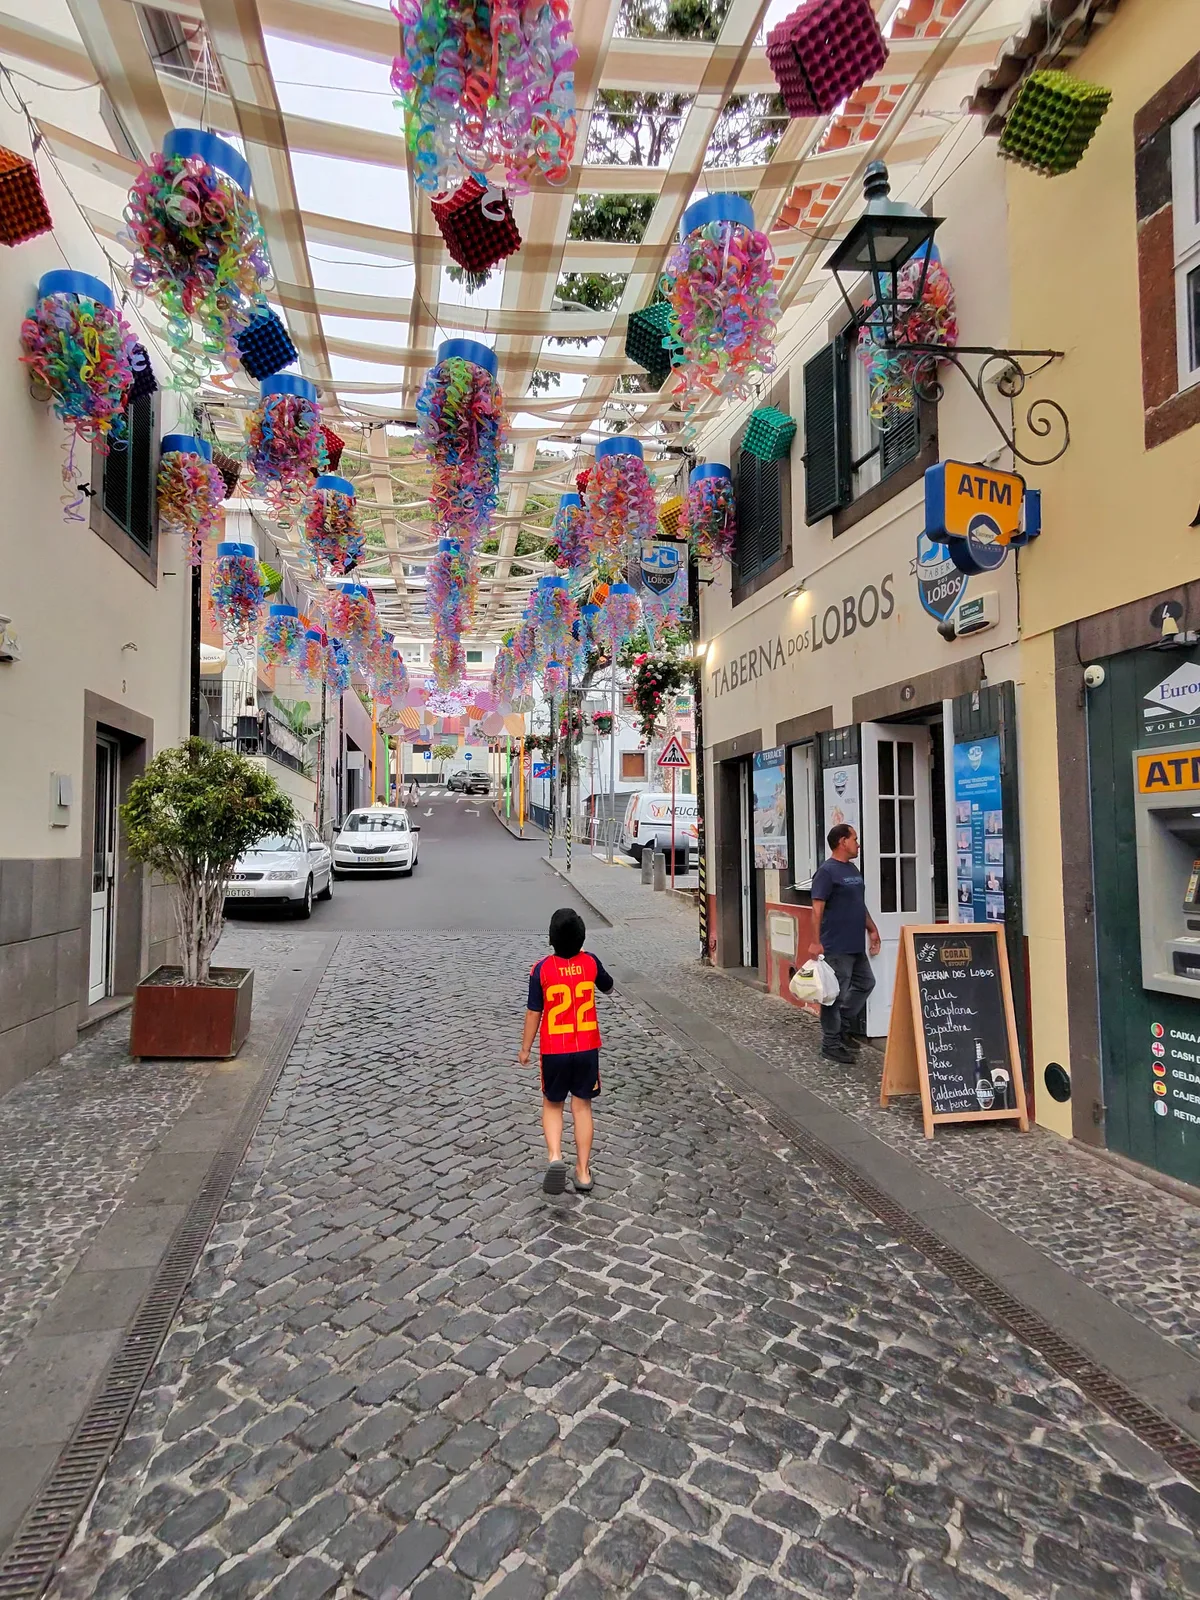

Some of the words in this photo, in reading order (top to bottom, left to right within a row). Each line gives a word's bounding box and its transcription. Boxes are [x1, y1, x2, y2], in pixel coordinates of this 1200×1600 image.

[957, 473, 1012, 506] ATM
[647, 576, 672, 584] LOBOS
[937, 576, 948, 585] DOS
[927, 577, 961, 605] LOBOS
[712, 635, 785, 698] TABERNA
[788, 630, 809, 657] DOS
[811, 573, 894, 652] LOBOS
[905, 687, 910, 699] 6
[1145, 718, 1196, 733] WORLD
[917, 942, 931, 961] COME
[925, 944, 938, 963] VISIT
[944, 950, 968, 959] CORAL
[558, 964, 582, 977] THÉO
[917, 970, 950, 982] TABERNA
[952, 970, 966, 979] DOS
[969, 968, 994, 978] LOBOS
[920, 988, 958, 1002] Paella
[546, 981, 597, 1035] 22
[923, 1001, 978, 1020] Cataplana
[1170, 1029, 1196, 1043] CAIXA
[1171, 1049, 1195, 1063] CASH
[976, 1090, 994, 1098] CORAL
